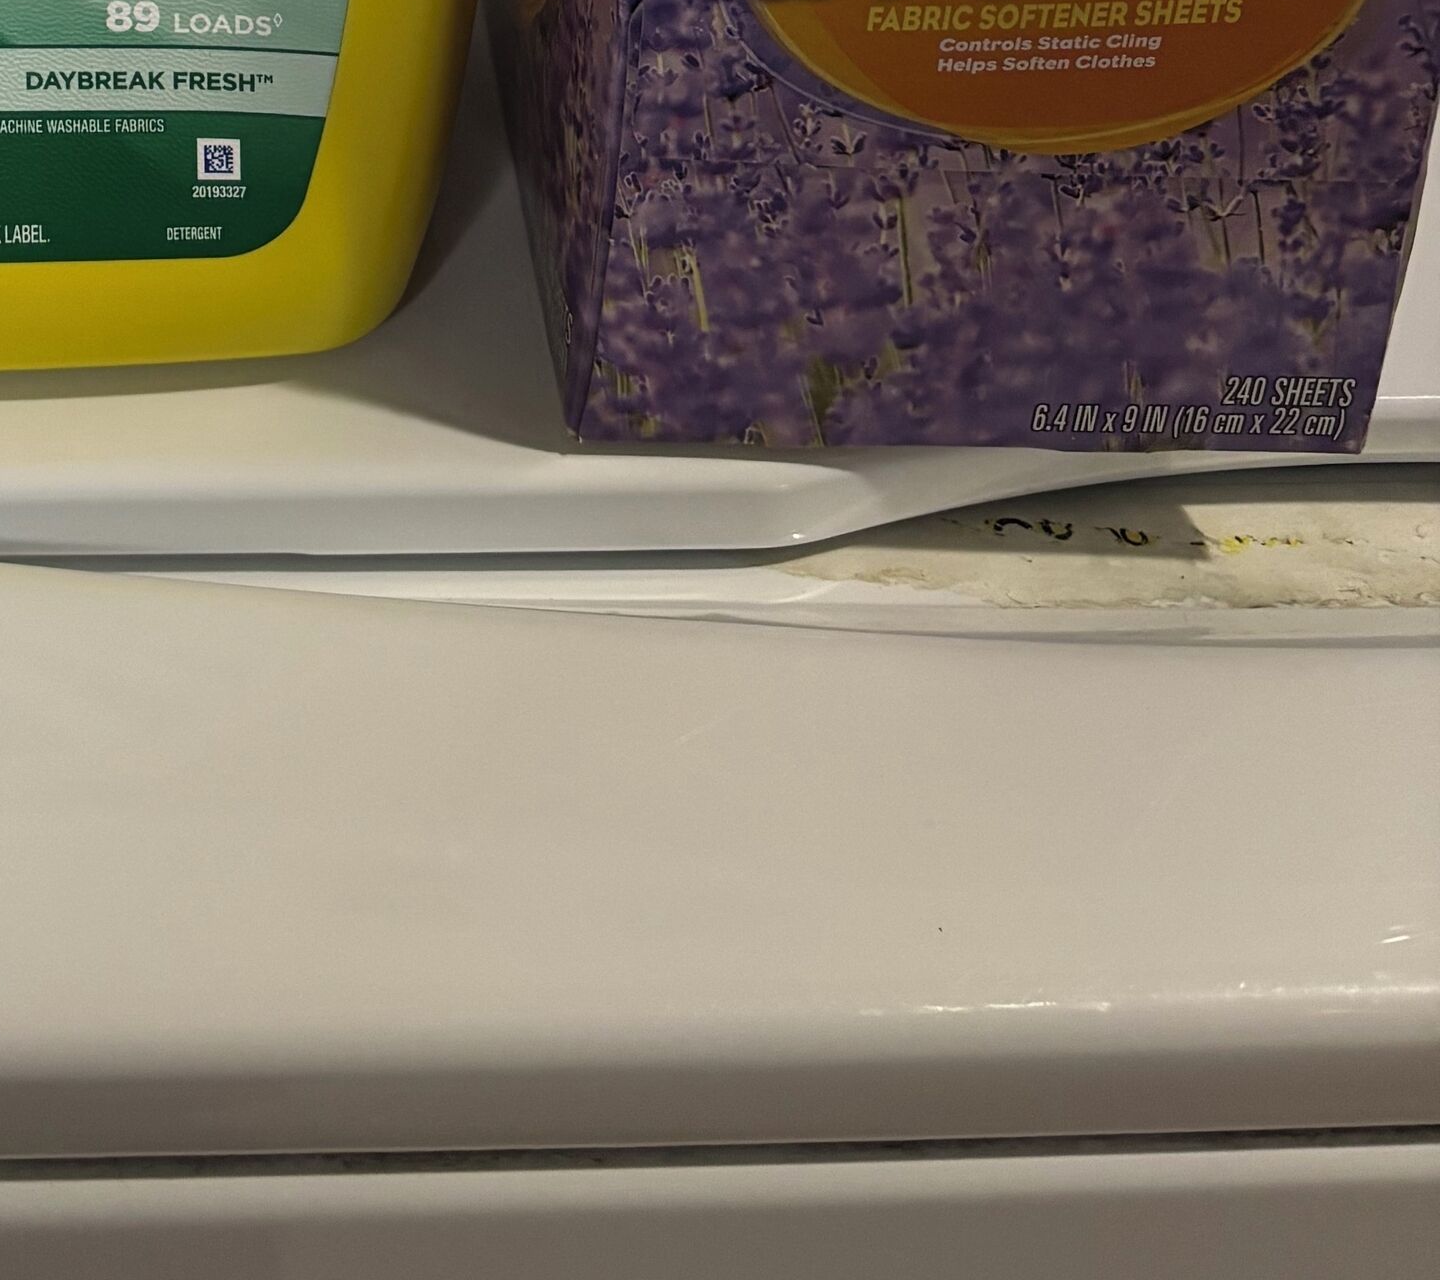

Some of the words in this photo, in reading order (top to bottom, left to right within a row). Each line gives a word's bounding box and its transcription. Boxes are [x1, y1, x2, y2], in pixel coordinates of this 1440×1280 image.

[105, 0, 160, 33] 89
[866, 5, 973, 32] FABRIC
[978, 1, 1130, 30] SOFTENER
[938, 36, 1033, 52] Controls
[1038, 34, 1101, 50] Static
[1105, 33, 1162, 51] Cling
[937, 56, 998, 74] Helps
[1002, 55, 1070, 72] Soften
[1074, 54, 1156, 70] Clothes
[25, 71, 166, 91] DAYBREAK
[46, 119, 111, 134] WASHABLE
[115, 118, 165, 133] FABRICS
[191, 185, 248, 199] 20193327
[4, 223, 52, 245] LABEL.
[166, 226, 223, 241] DETERGENT
[1222, 376, 1264, 406] 240
[1271, 377, 1357, 408] SHEETS
[1031, 404, 1067, 433] 6.4
[1072, 405, 1097, 433] IN
[1103, 412, 1116, 434] x
[1123, 405, 1138, 433] 9
[1138, 405, 1170, 433] IN
[1172, 406, 1209, 439] (16
[1212, 412, 1247, 436] cm
[1248, 413, 1264, 435] x
[1268, 407, 1302, 435] 22
[1303, 408, 1347, 440] cm)
